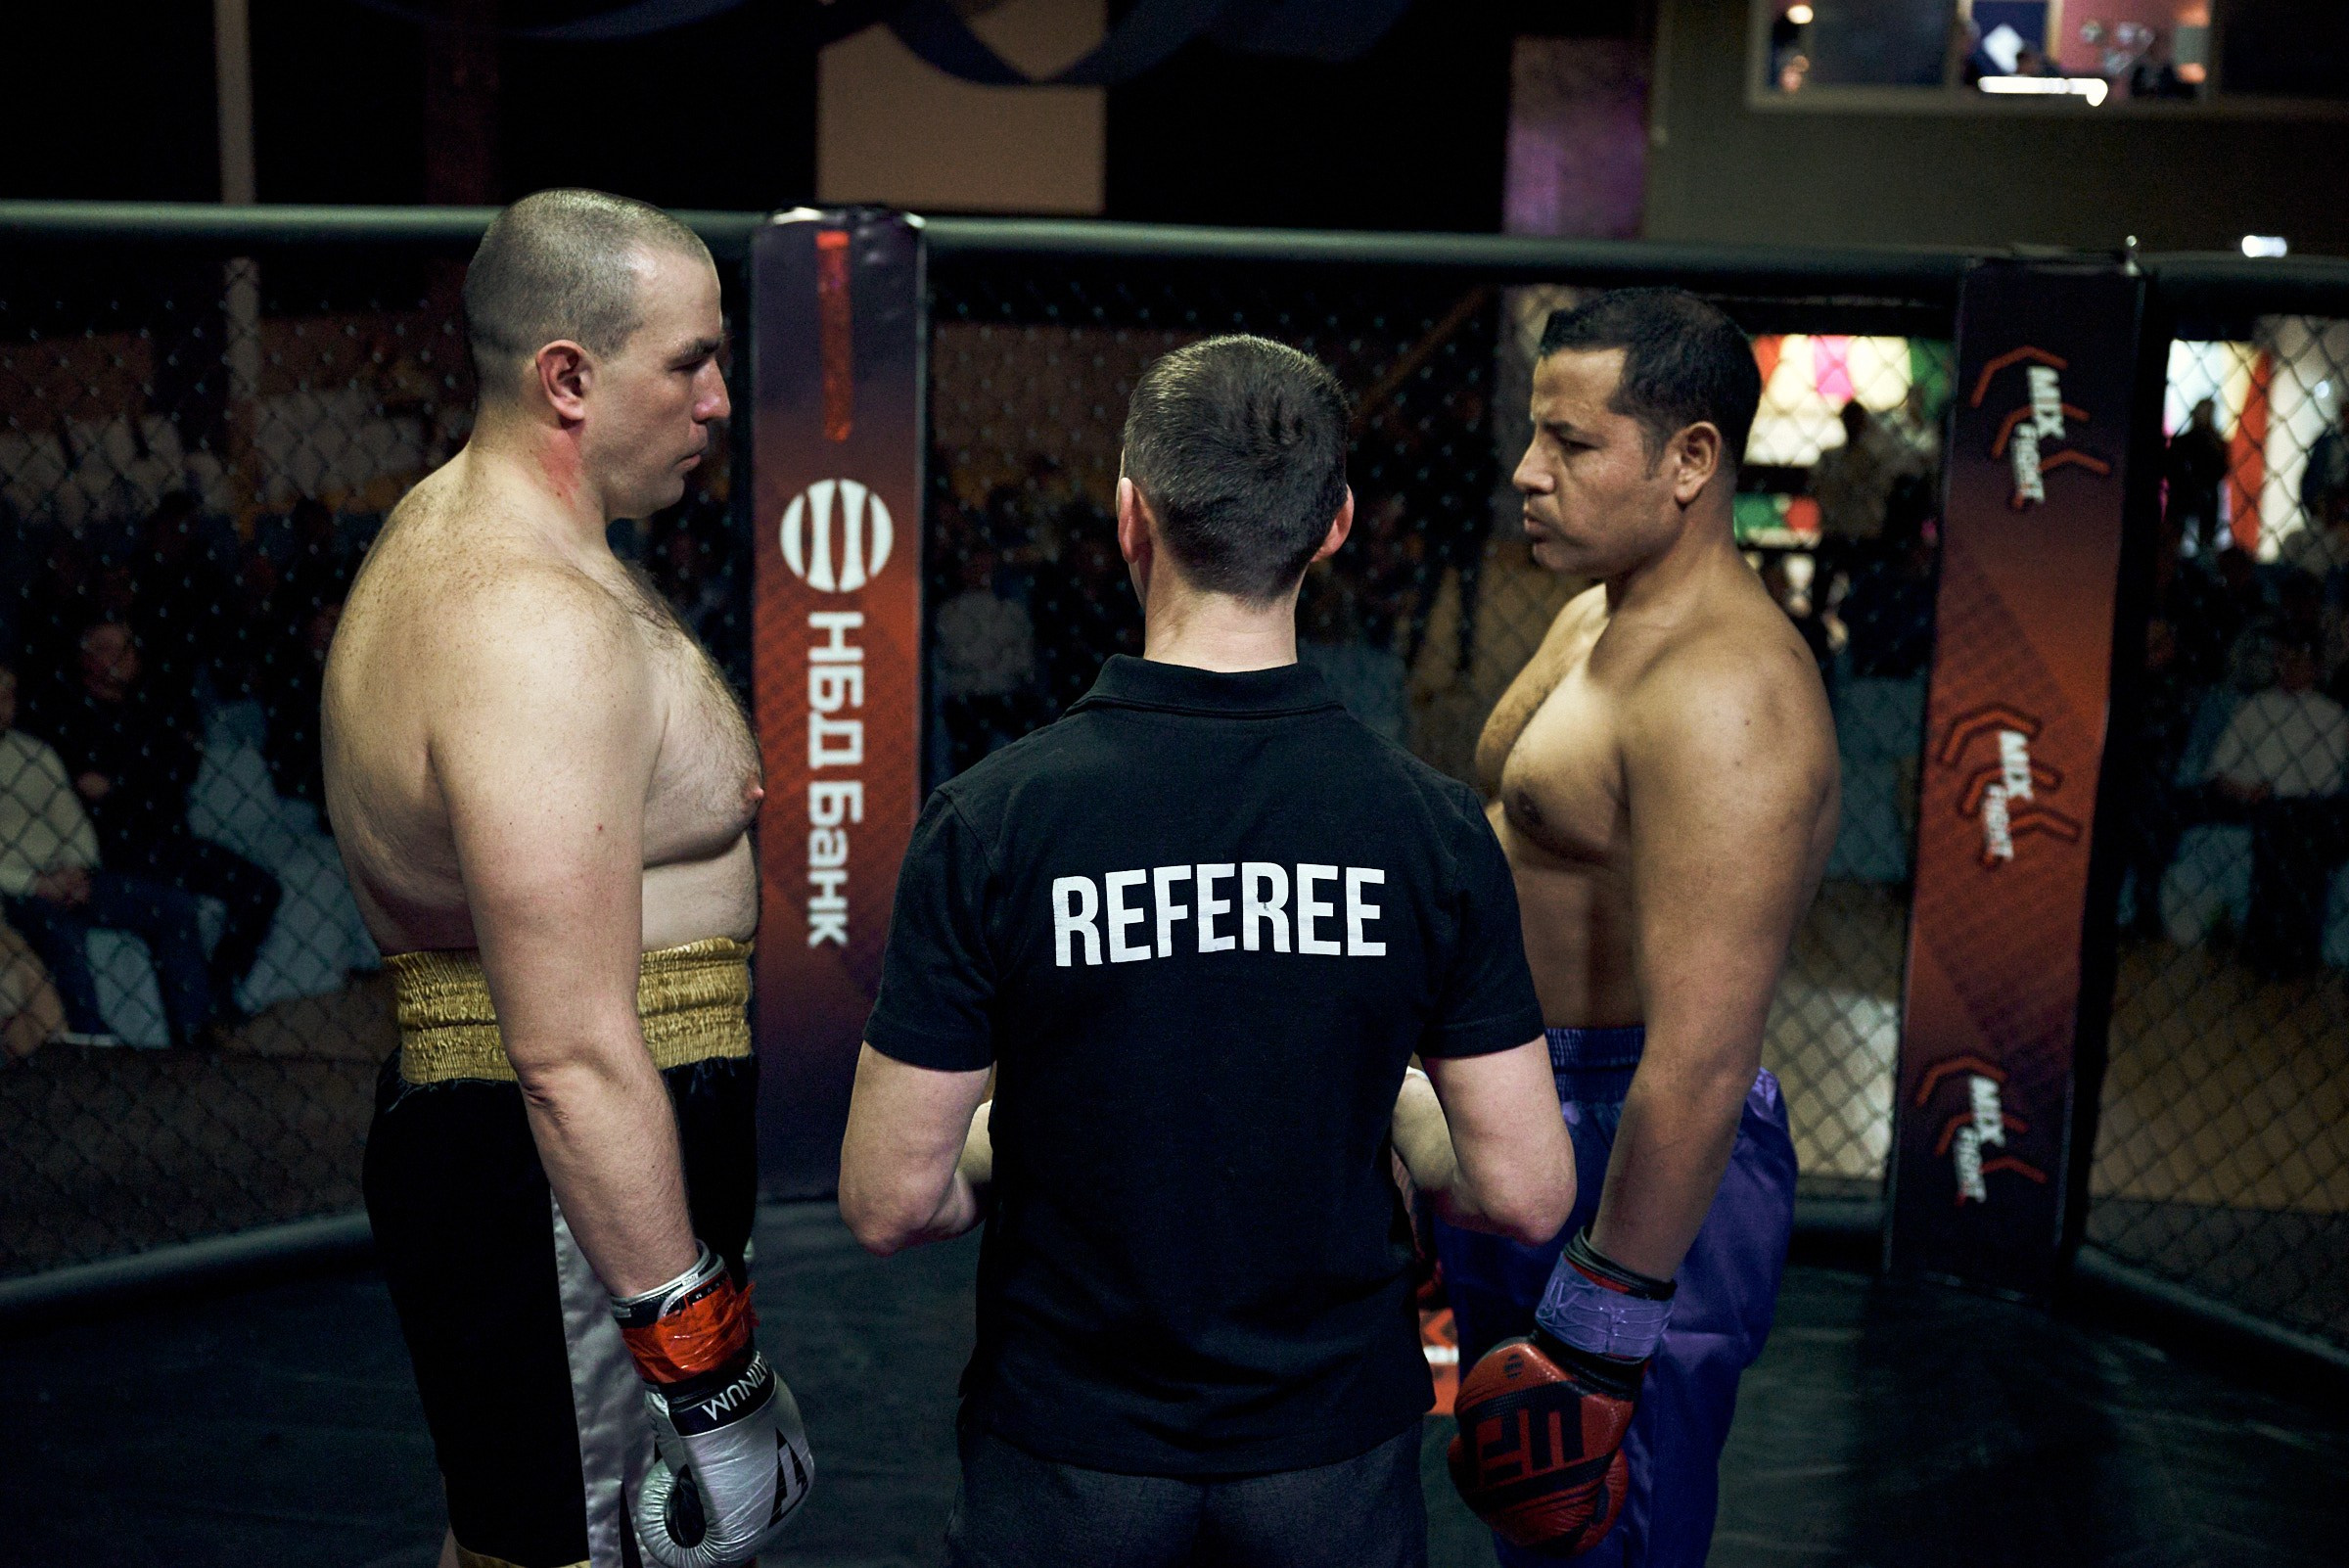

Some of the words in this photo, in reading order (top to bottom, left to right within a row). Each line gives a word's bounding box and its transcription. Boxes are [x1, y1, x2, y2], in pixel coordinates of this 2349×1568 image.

[2026, 365, 2066, 440] MIX
[807, 611, 864, 770] НБД
[1999, 730, 2035, 803] MIX
[807, 782, 864, 948] Банк
[1051, 861, 1387, 967] REFEREE
[1968, 1075, 2006, 1148] MIX
[702, 1352, 769, 1421] ATINUM
